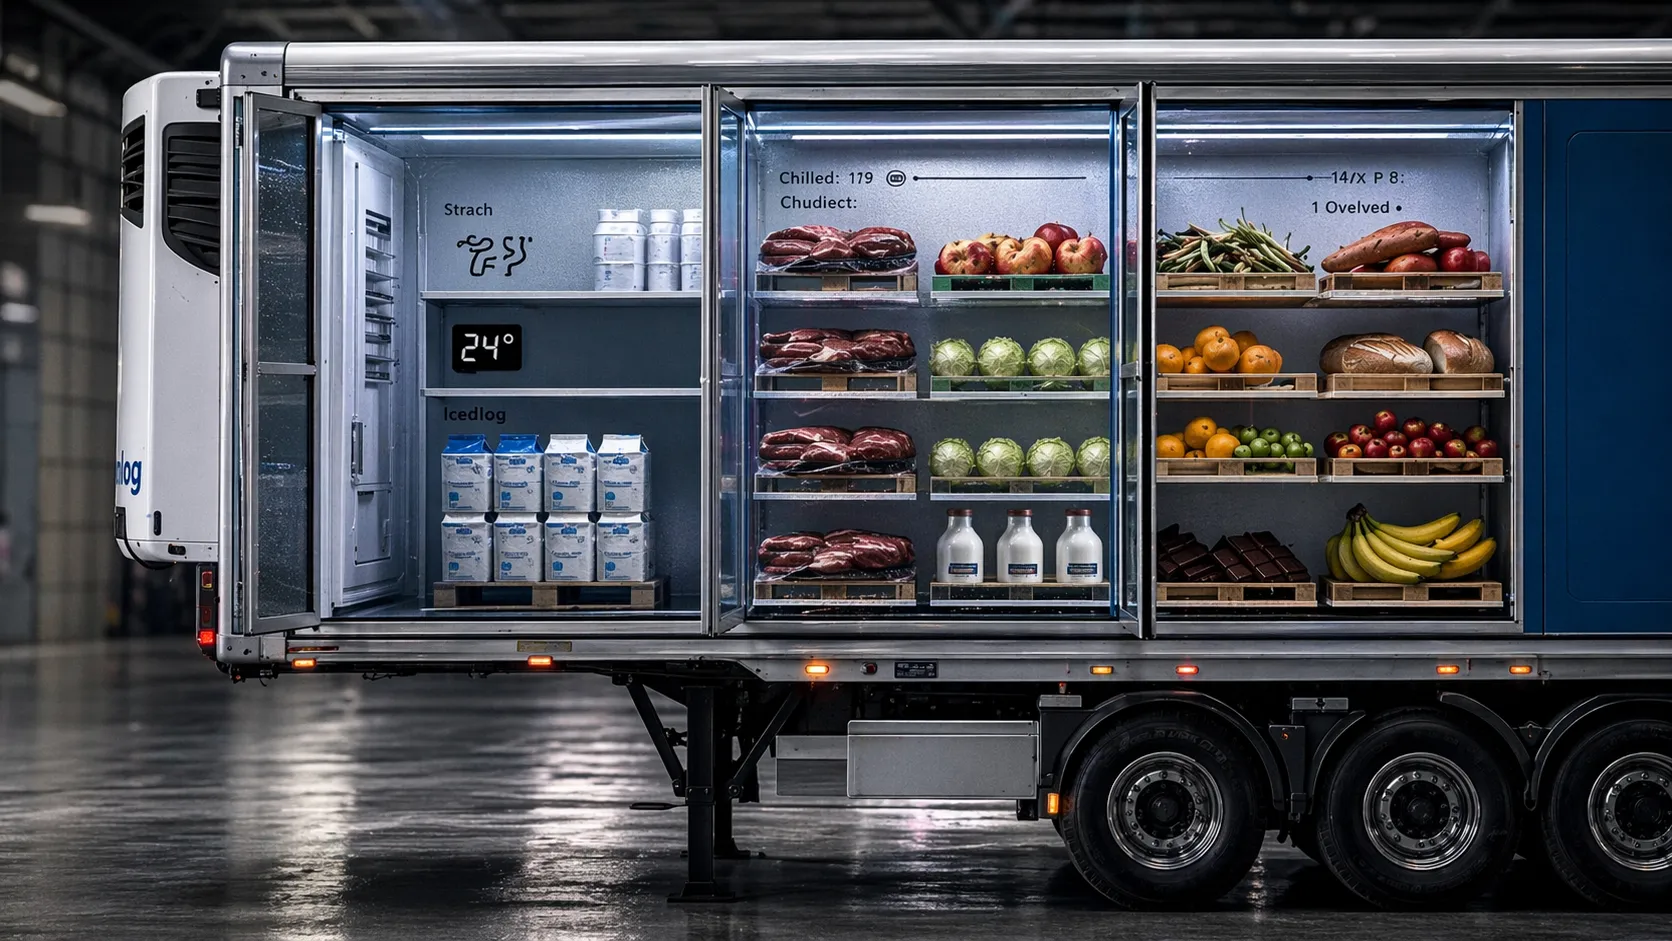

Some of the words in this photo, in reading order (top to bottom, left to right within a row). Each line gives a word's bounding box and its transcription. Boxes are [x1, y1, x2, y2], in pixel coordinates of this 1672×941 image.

[779, 170, 839, 185] Chilled:
[849, 171, 874, 185] 179
[1374, 171, 1384, 184] P
[1389, 171, 1405, 184] 8:
[780, 195, 857, 209] Chudiect:
[1325, 200, 1390, 214] Ovelved
[444, 203, 493, 216] Strach
[444, 406, 506, 425] Icedlog
